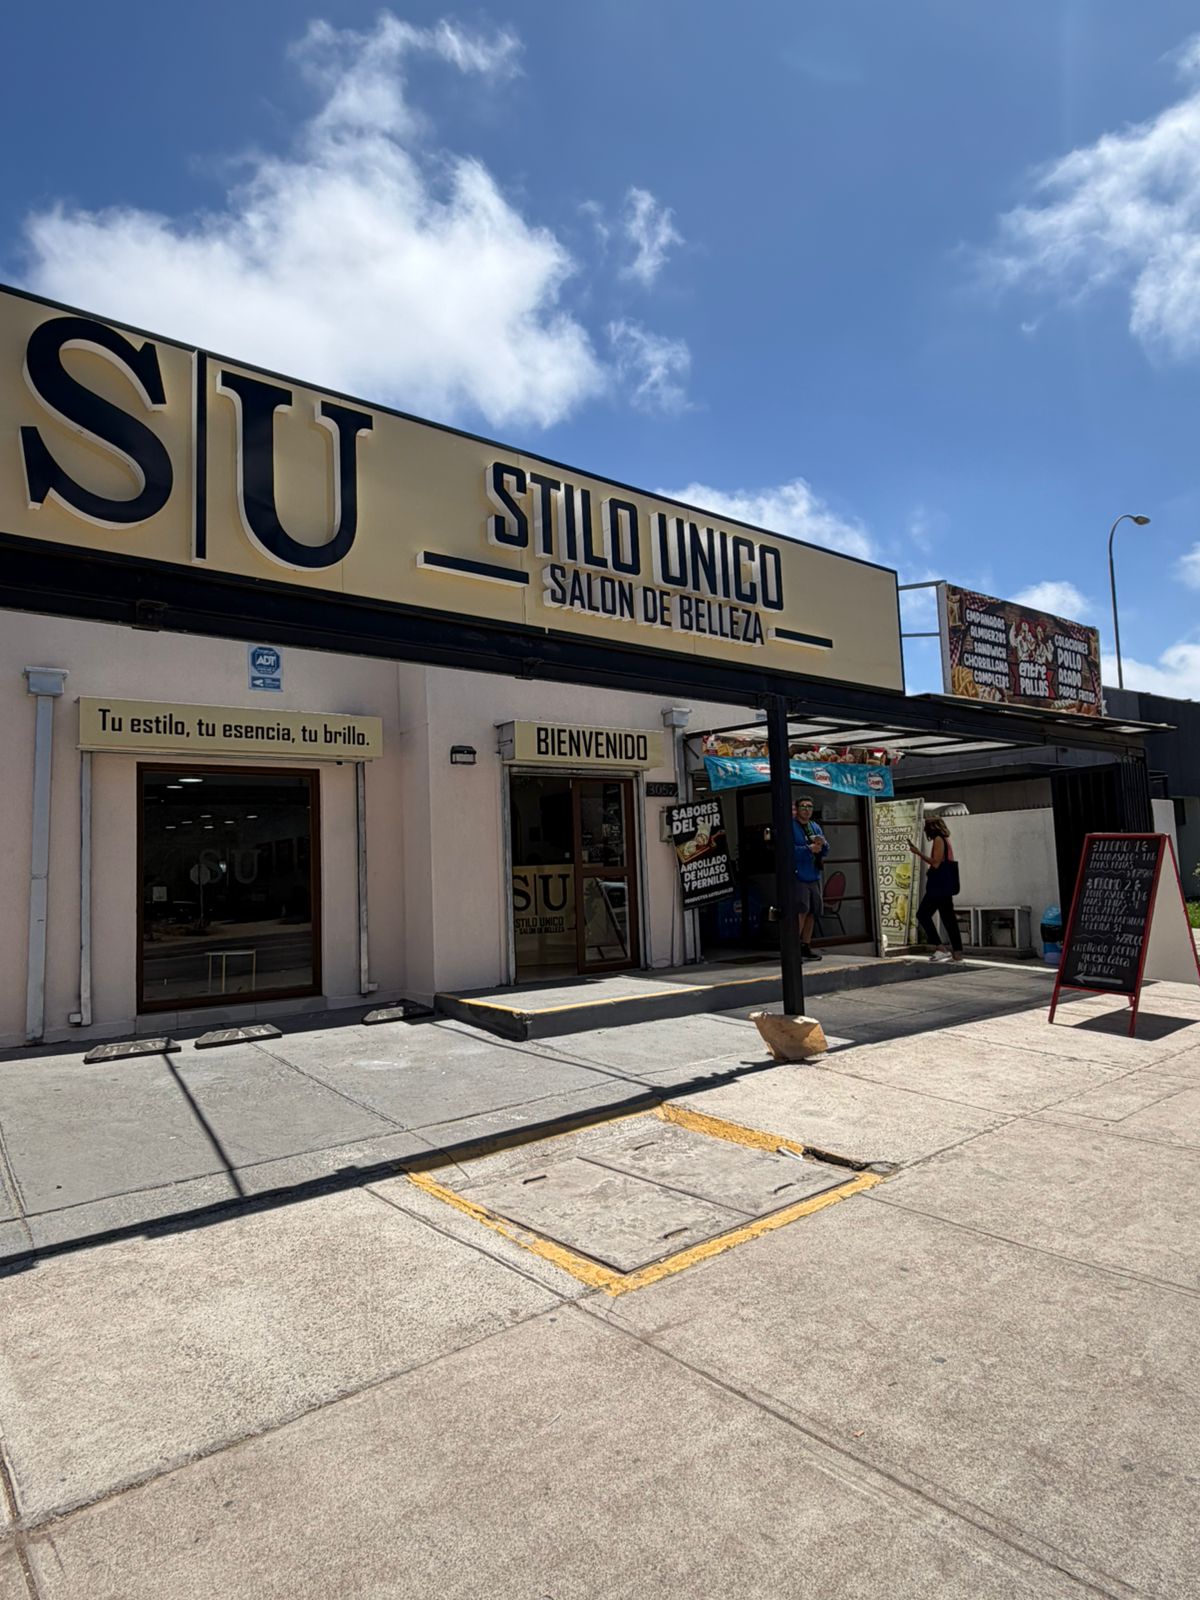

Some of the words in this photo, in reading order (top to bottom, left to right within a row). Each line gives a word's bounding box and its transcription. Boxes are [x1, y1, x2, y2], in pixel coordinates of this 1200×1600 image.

[489, 461, 641, 577] STILO
[654, 511, 785, 612] UNICO
[546, 563, 635, 621] SALON
[640, 585, 672, 628] DE
[676, 594, 765, 646] BELLEZA
[256, 655, 277, 666] ADT
[1057, 648, 1082, 671] POLLO
[1019, 677, 1049, 697] POLLOS
[1058, 667, 1082, 688] ASADO
[98, 708, 123, 732] Tu
[130, 713, 191, 738] estilo,
[197, 717, 216, 738] tu
[222, 722, 296, 744] esencia,
[301, 725, 318, 743] tu
[323, 723, 370, 746] brillo.
[536, 727, 648, 761] BIENVENIDO
[671, 802, 719, 821] SABORES
[672, 819, 695, 835] DEL
[696, 812, 721, 828] SUR
[680, 854, 728, 873] ARROLLADO
[684, 870, 697, 882] DE
[697, 863, 726, 880] HUASO
[683, 882, 691, 893] Y
[691, 872, 730, 891] PERNILES
